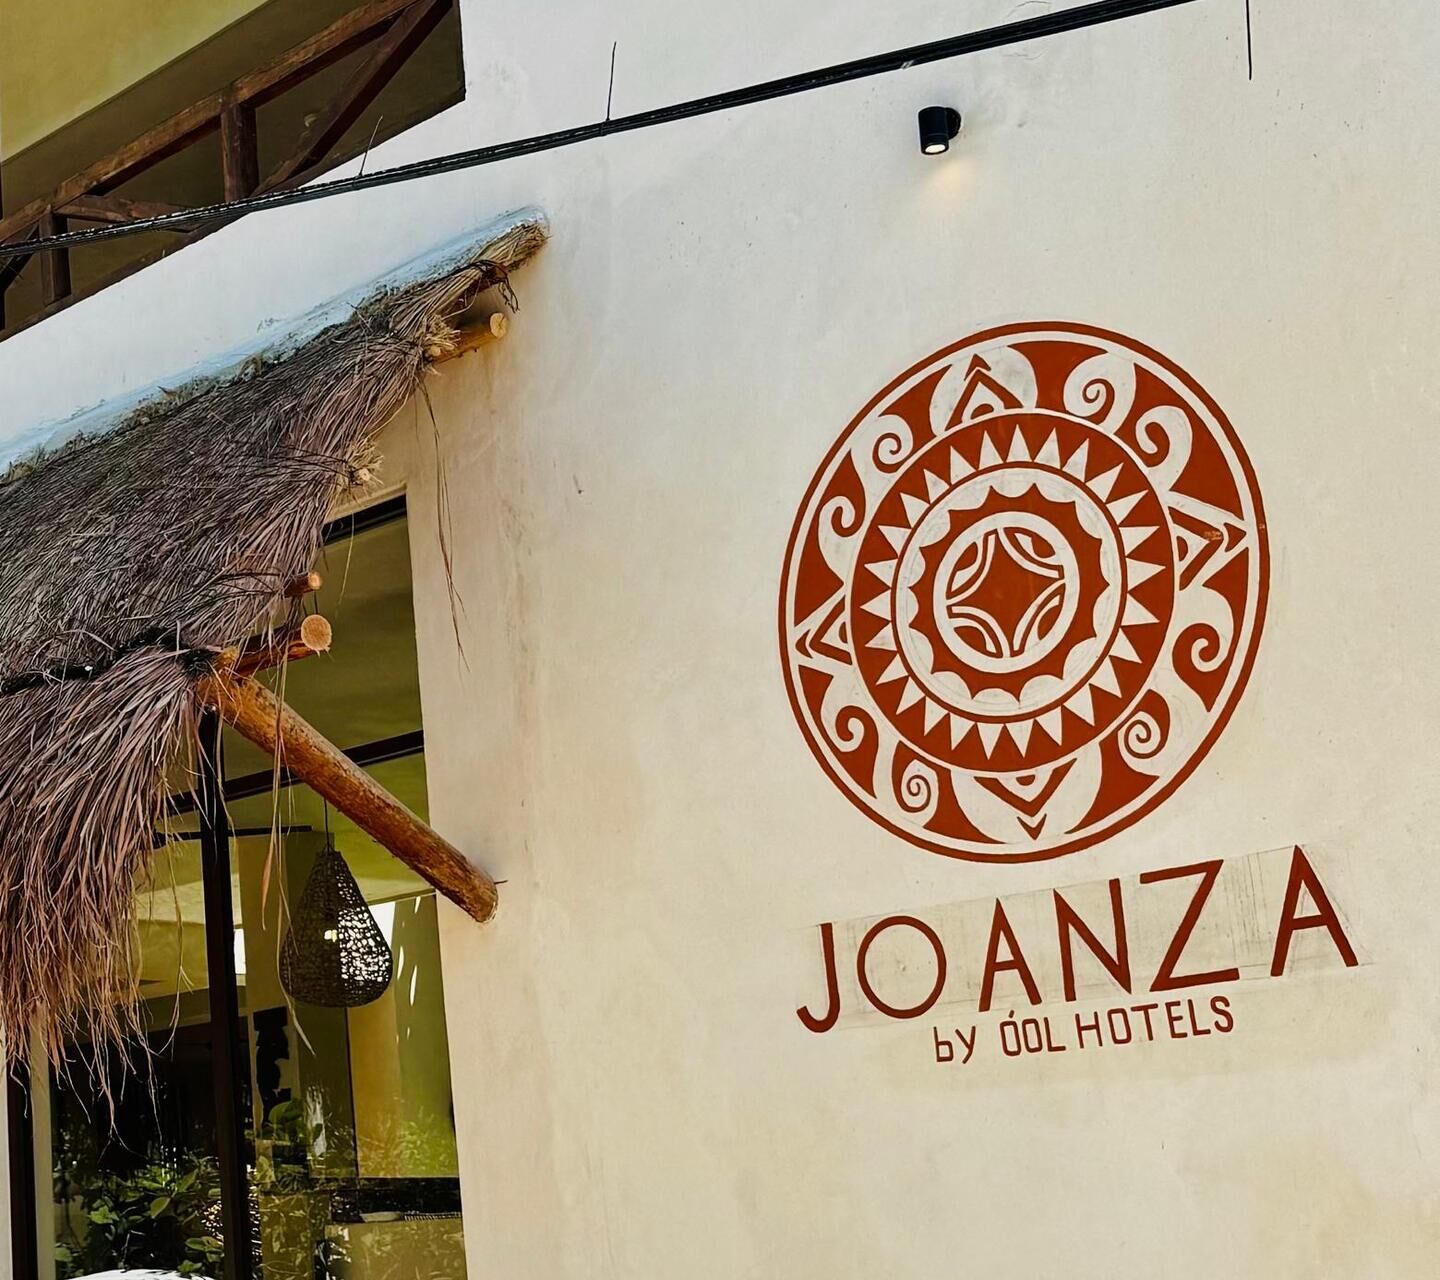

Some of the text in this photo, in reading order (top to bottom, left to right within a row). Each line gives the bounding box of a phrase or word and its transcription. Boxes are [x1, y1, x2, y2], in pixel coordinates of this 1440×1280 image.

[796, 845, 1359, 1034] JOANZA
[933, 995, 1234, 1064] by ÓOL HOTELS
